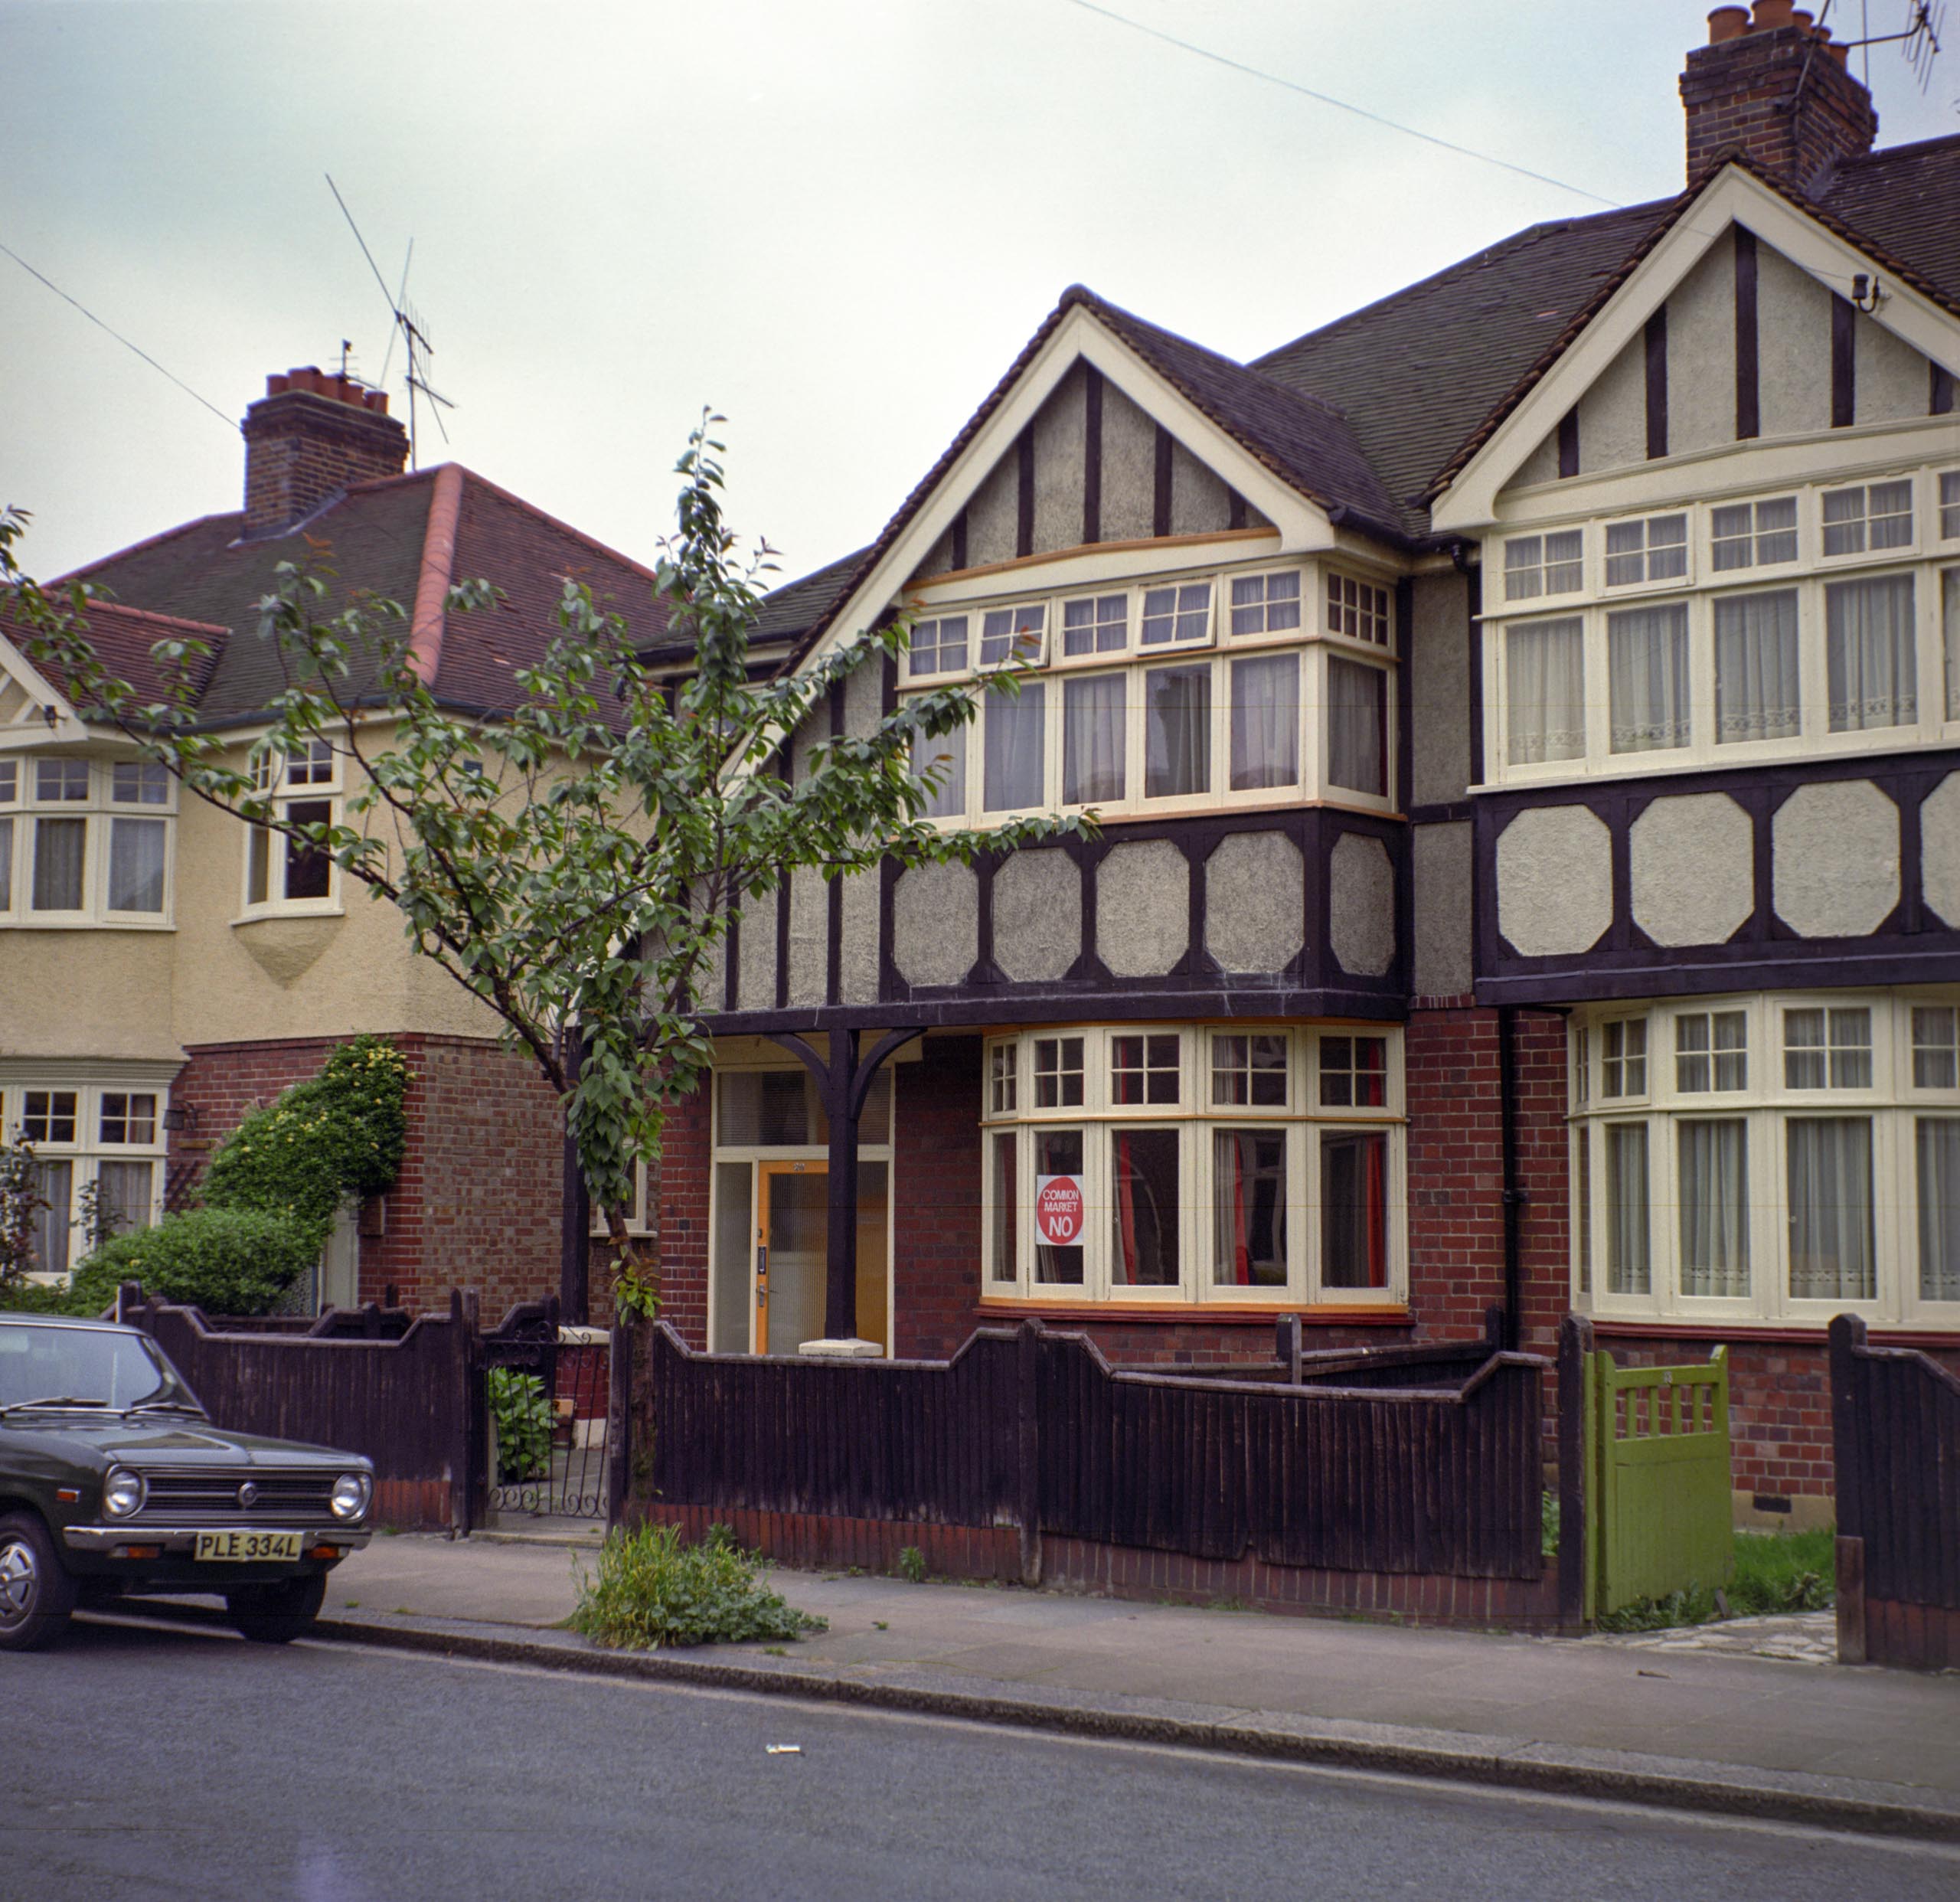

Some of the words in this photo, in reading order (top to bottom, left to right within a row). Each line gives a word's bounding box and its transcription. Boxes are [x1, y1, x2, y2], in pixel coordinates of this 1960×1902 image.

[1042, 1189, 1080, 1201] COMMON
[1044, 1201, 1078, 1212] MARKET
[1049, 1216, 1073, 1237] NO
[200, 1535, 240, 1557] PLE
[245, 1535, 298, 1557] 334L
